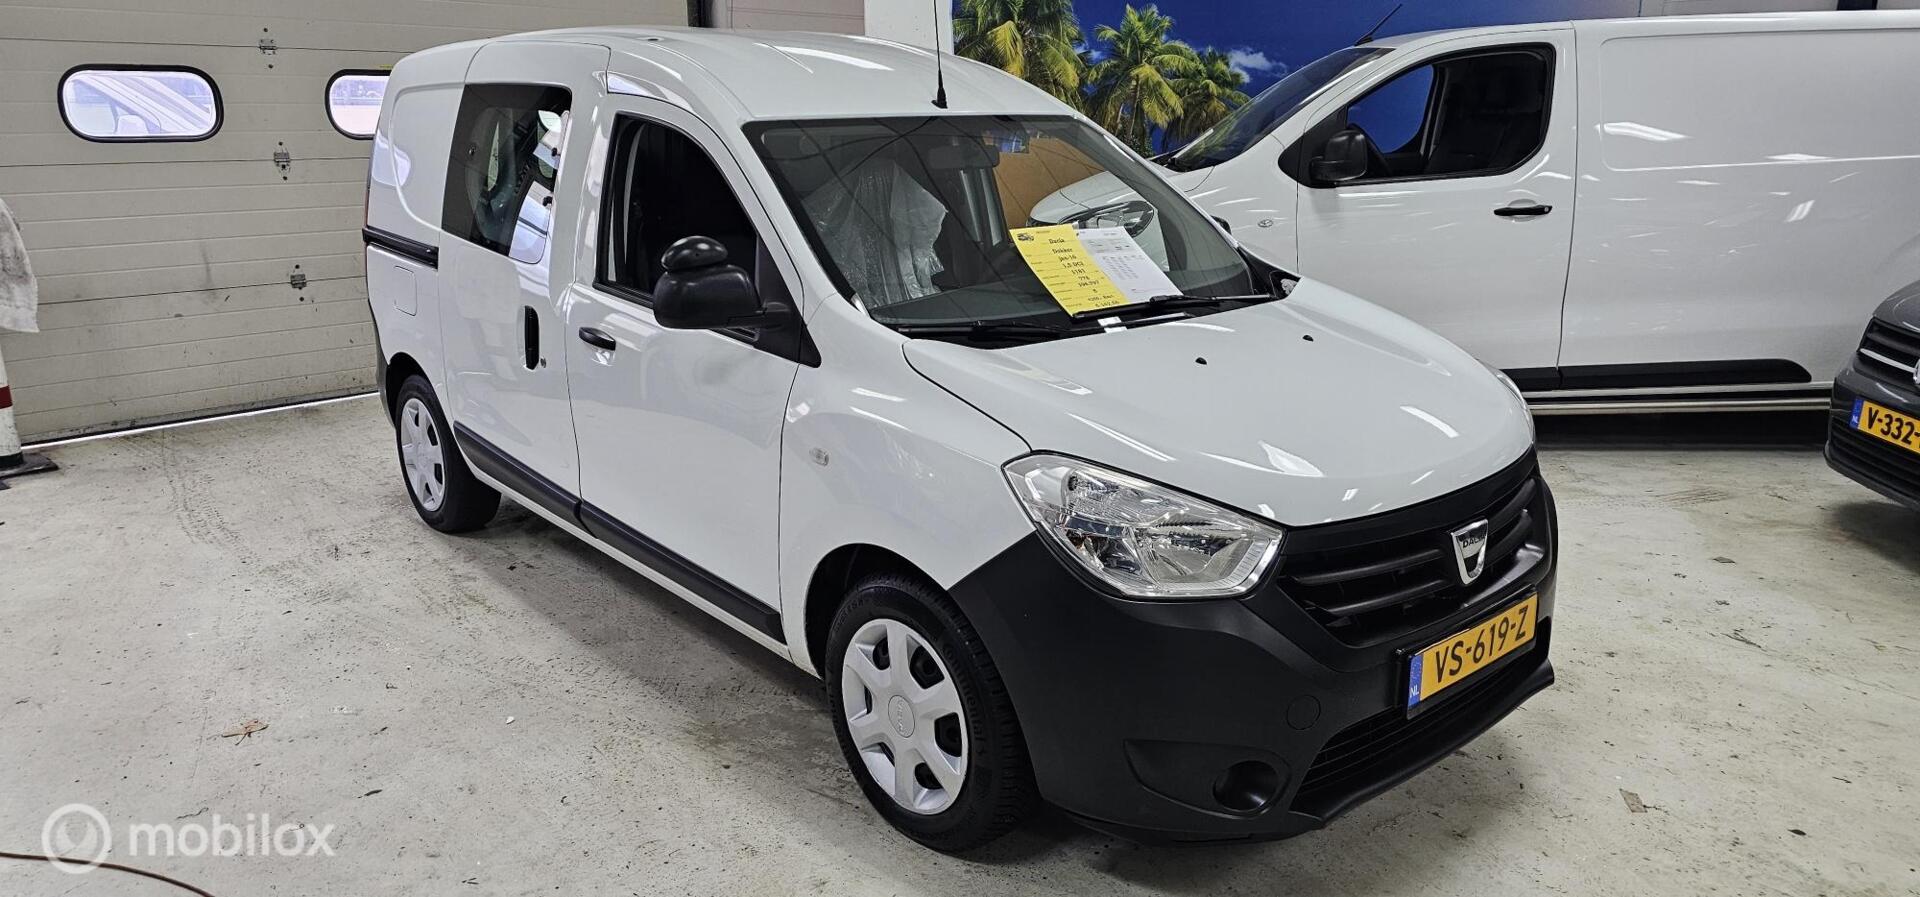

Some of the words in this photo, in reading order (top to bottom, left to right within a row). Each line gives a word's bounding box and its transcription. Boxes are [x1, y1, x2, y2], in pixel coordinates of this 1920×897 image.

[1868, 407, 1920, 447] V-332-
[1436, 605, 1529, 683] VS-619-Z
[1409, 684, 1420, 698] NL
